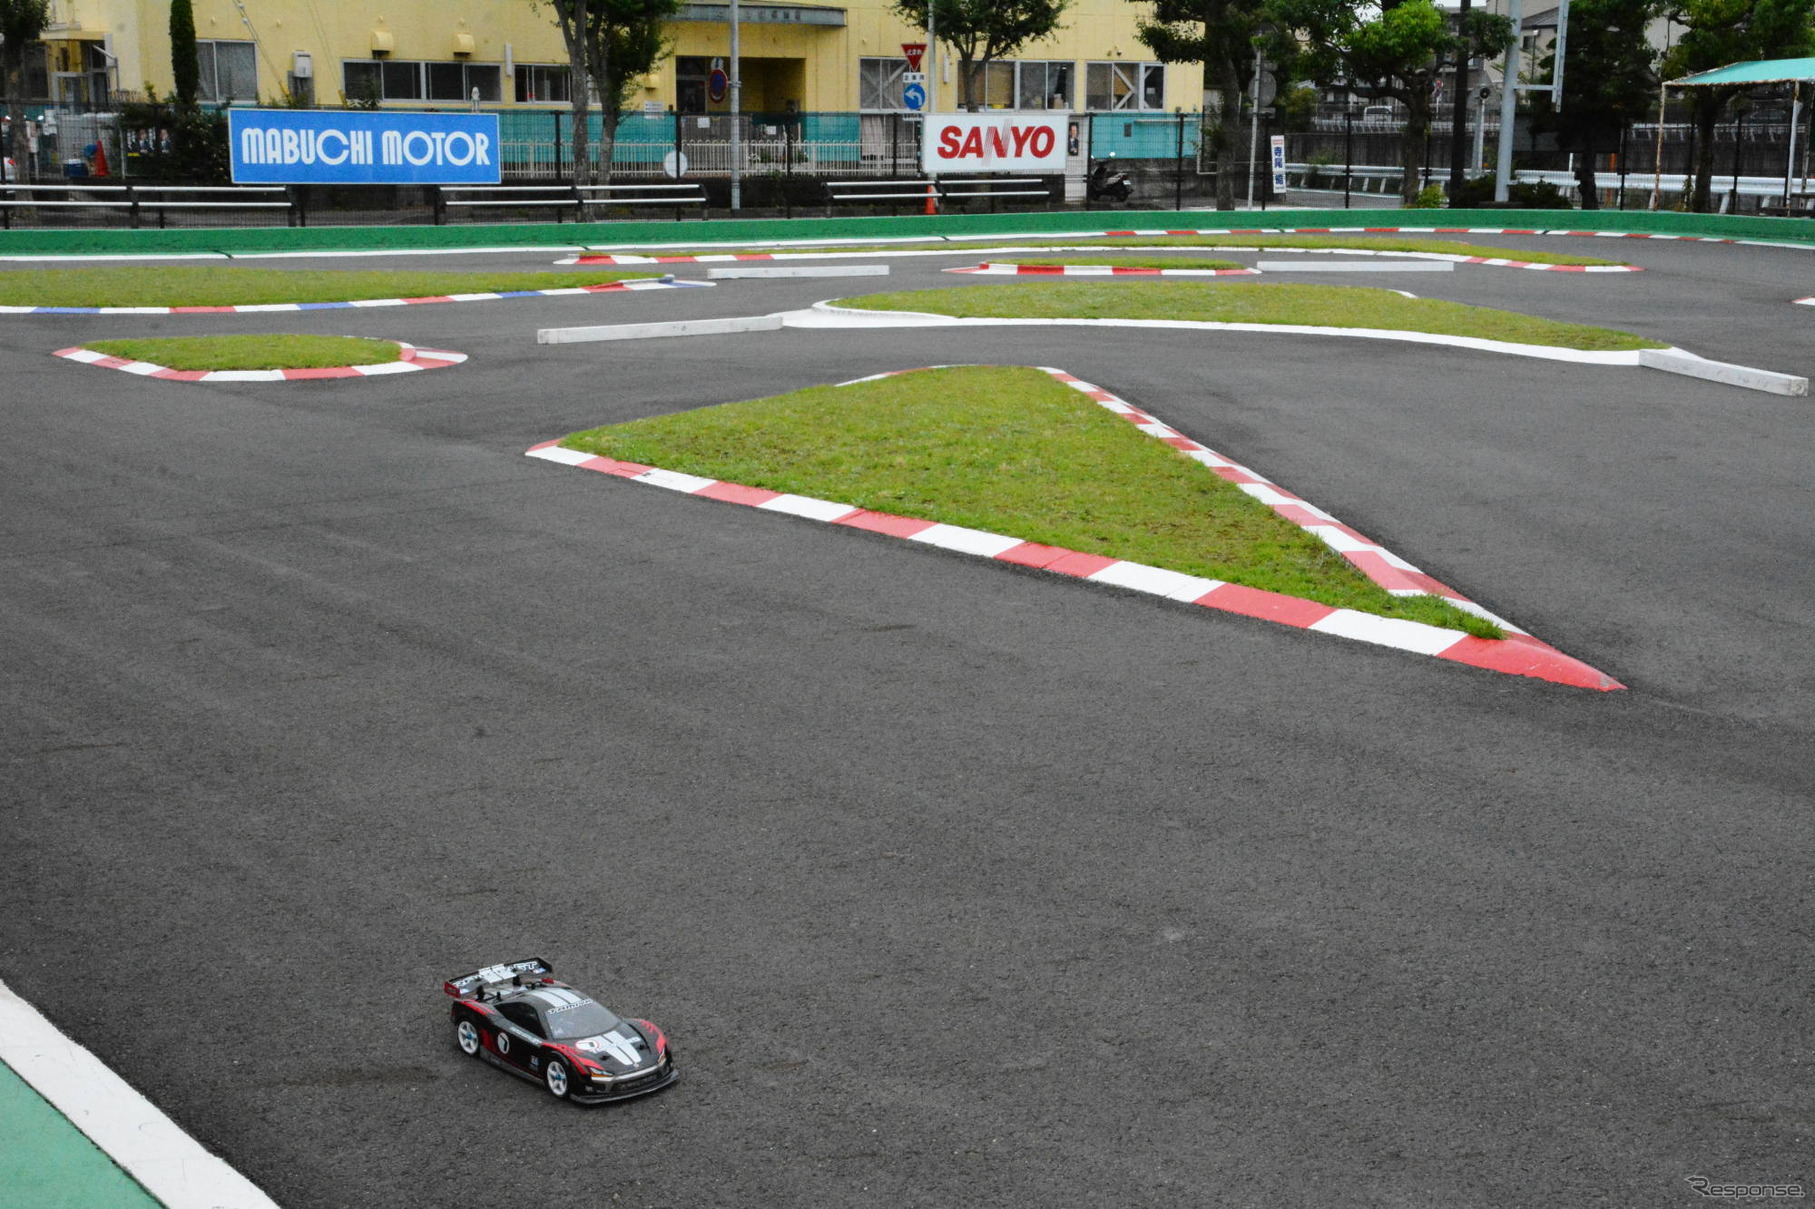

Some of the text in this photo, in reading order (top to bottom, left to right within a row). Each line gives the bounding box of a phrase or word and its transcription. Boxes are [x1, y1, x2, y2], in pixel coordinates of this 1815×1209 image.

[241, 128, 491, 166] MABUCHI MOTOR
[937, 120, 1056, 164] SANYO
